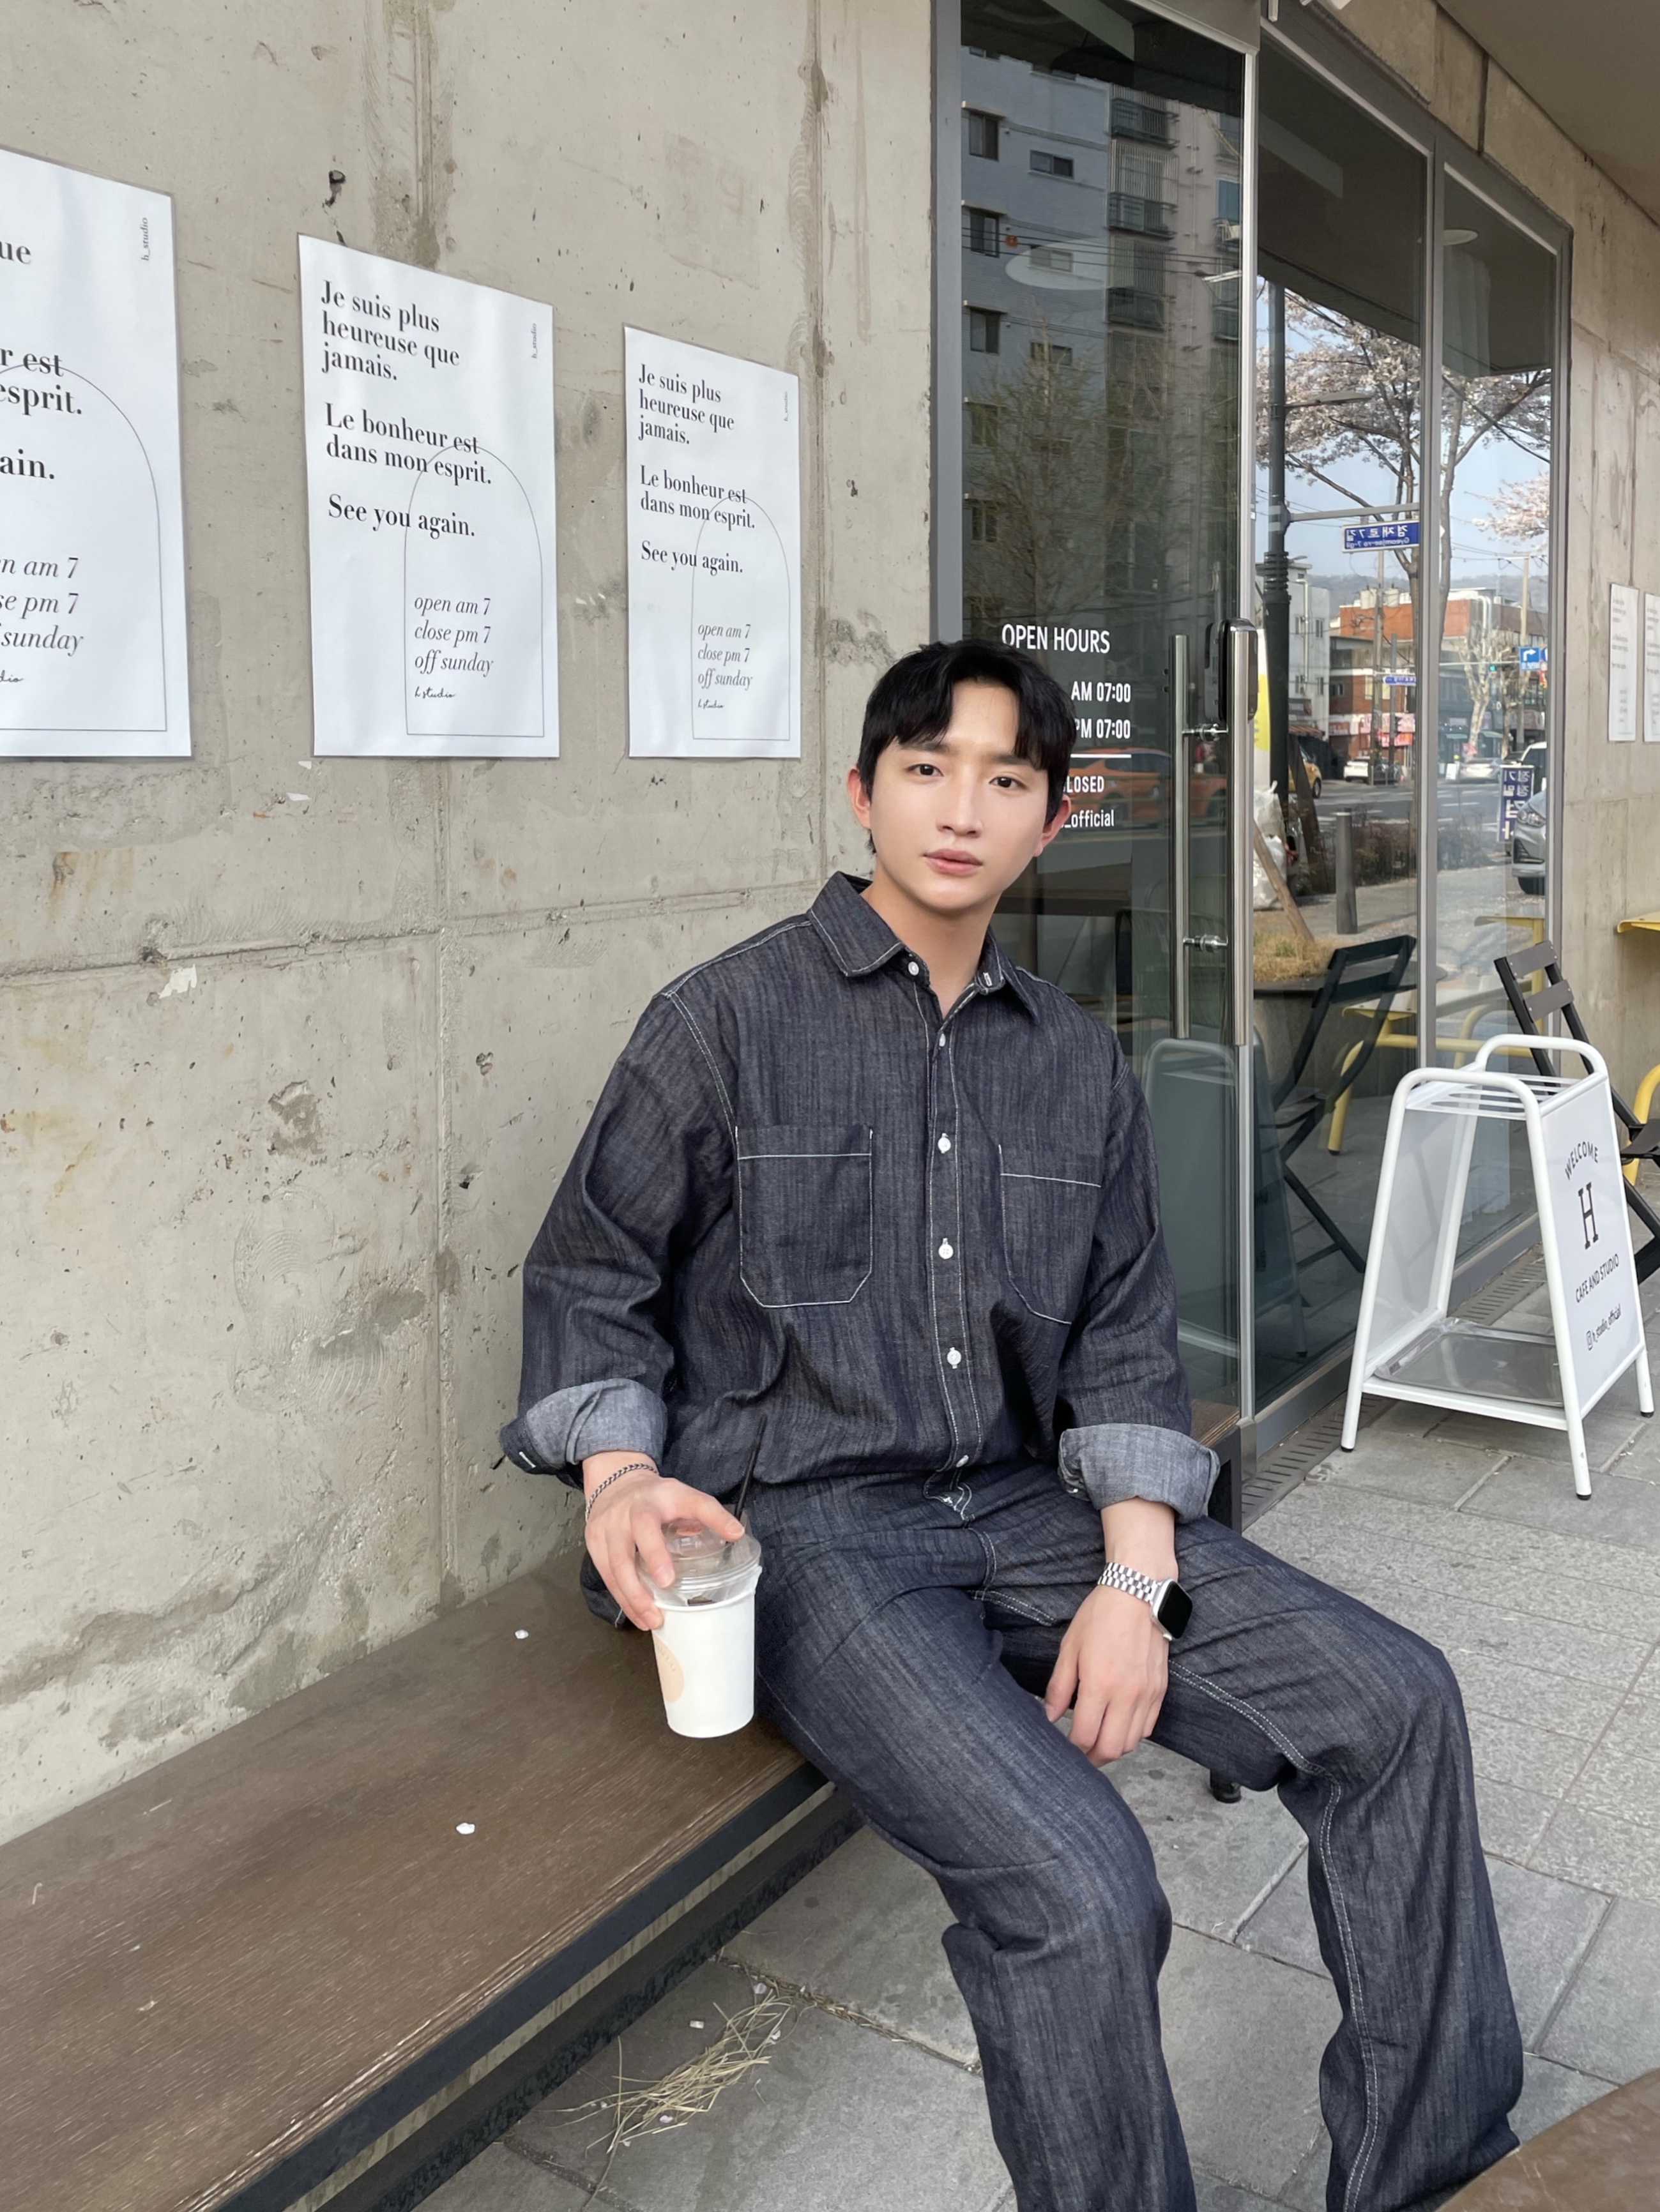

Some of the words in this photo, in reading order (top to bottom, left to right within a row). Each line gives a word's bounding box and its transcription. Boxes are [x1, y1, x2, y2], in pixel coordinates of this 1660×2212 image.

[321, 280, 345, 308] Je
[352, 295, 390, 320] suis
[398, 303, 439, 333] plus
[322, 310, 418, 356] heureuse
[424, 342, 460, 369] que
[23, 353, 64, 377] est
[321, 342, 397, 381] jamais.
[639, 363, 655, 386] Je
[659, 374, 687, 394] suis
[692, 379, 722, 404] plus
[639, 388, 706, 423] heureuse
[709, 413, 735, 434] que
[324, 402, 354, 430] Le
[362, 409, 448, 449] bonheur
[453, 436, 480, 455] est
[638, 414, 690, 444] jamais.
[326, 434, 377, 465] dans
[385, 451, 429, 473] mon
[434, 460, 492, 486] esprit.
[640, 464, 659, 487] Le
[664, 469, 725, 500] bonheur
[727, 489, 747, 504] est
[328, 494, 367, 522] See
[372, 508, 411, 532] you
[418, 513, 475, 540] again.
[641, 490, 675, 515] dans
[680, 503, 710, 521] mon
[714, 509, 755, 531] esprit.
[24, 560, 59, 578] am
[68, 557, 79, 579] 7
[641, 540, 667, 564] See
[671, 551, 697, 570] you
[703, 553, 743, 576] again.
[20, 595, 59, 619] pm
[68, 593, 79, 614] 7
[414, 596, 451, 617] open
[455, 600, 478, 614] am
[484, 598, 491, 615] 7
[1, 625, 84, 657] sunday
[414, 619, 451, 641] close
[453, 629, 478, 648] pm
[484, 626, 491, 643] 7
[698, 624, 723, 640] open
[726, 626, 741, 638] am
[745, 624, 750, 639] 7
[1001, 623, 1048, 650] OPEN
[1053, 627, 1110, 654] HOURS
[415, 649, 441, 675] off
[440, 652, 494, 678] sunday
[698, 643, 722, 661] close
[723, 651, 741, 667] pm
[745, 648, 750, 662] 7
[698, 668, 715, 689] off
[715, 669, 753, 691] sunday
[1070, 681, 1092, 701] AM
[1096, 682, 1131, 702] 07:00
[1096, 718, 1131, 739] 07:00
[1063, 775, 1105, 793] LOSED
[1061, 809, 1115, 828] _official
[1564, 1141, 1599, 1180] WELCOME
[1578, 1181, 1599, 1250] H
[1575, 1280, 1588, 1303] CAFE
[1588, 1270, 1601, 1292] AND
[1600, 1253, 1620, 1284] STUDIO
[1592, 1304, 1621, 1344] h_studio_official
